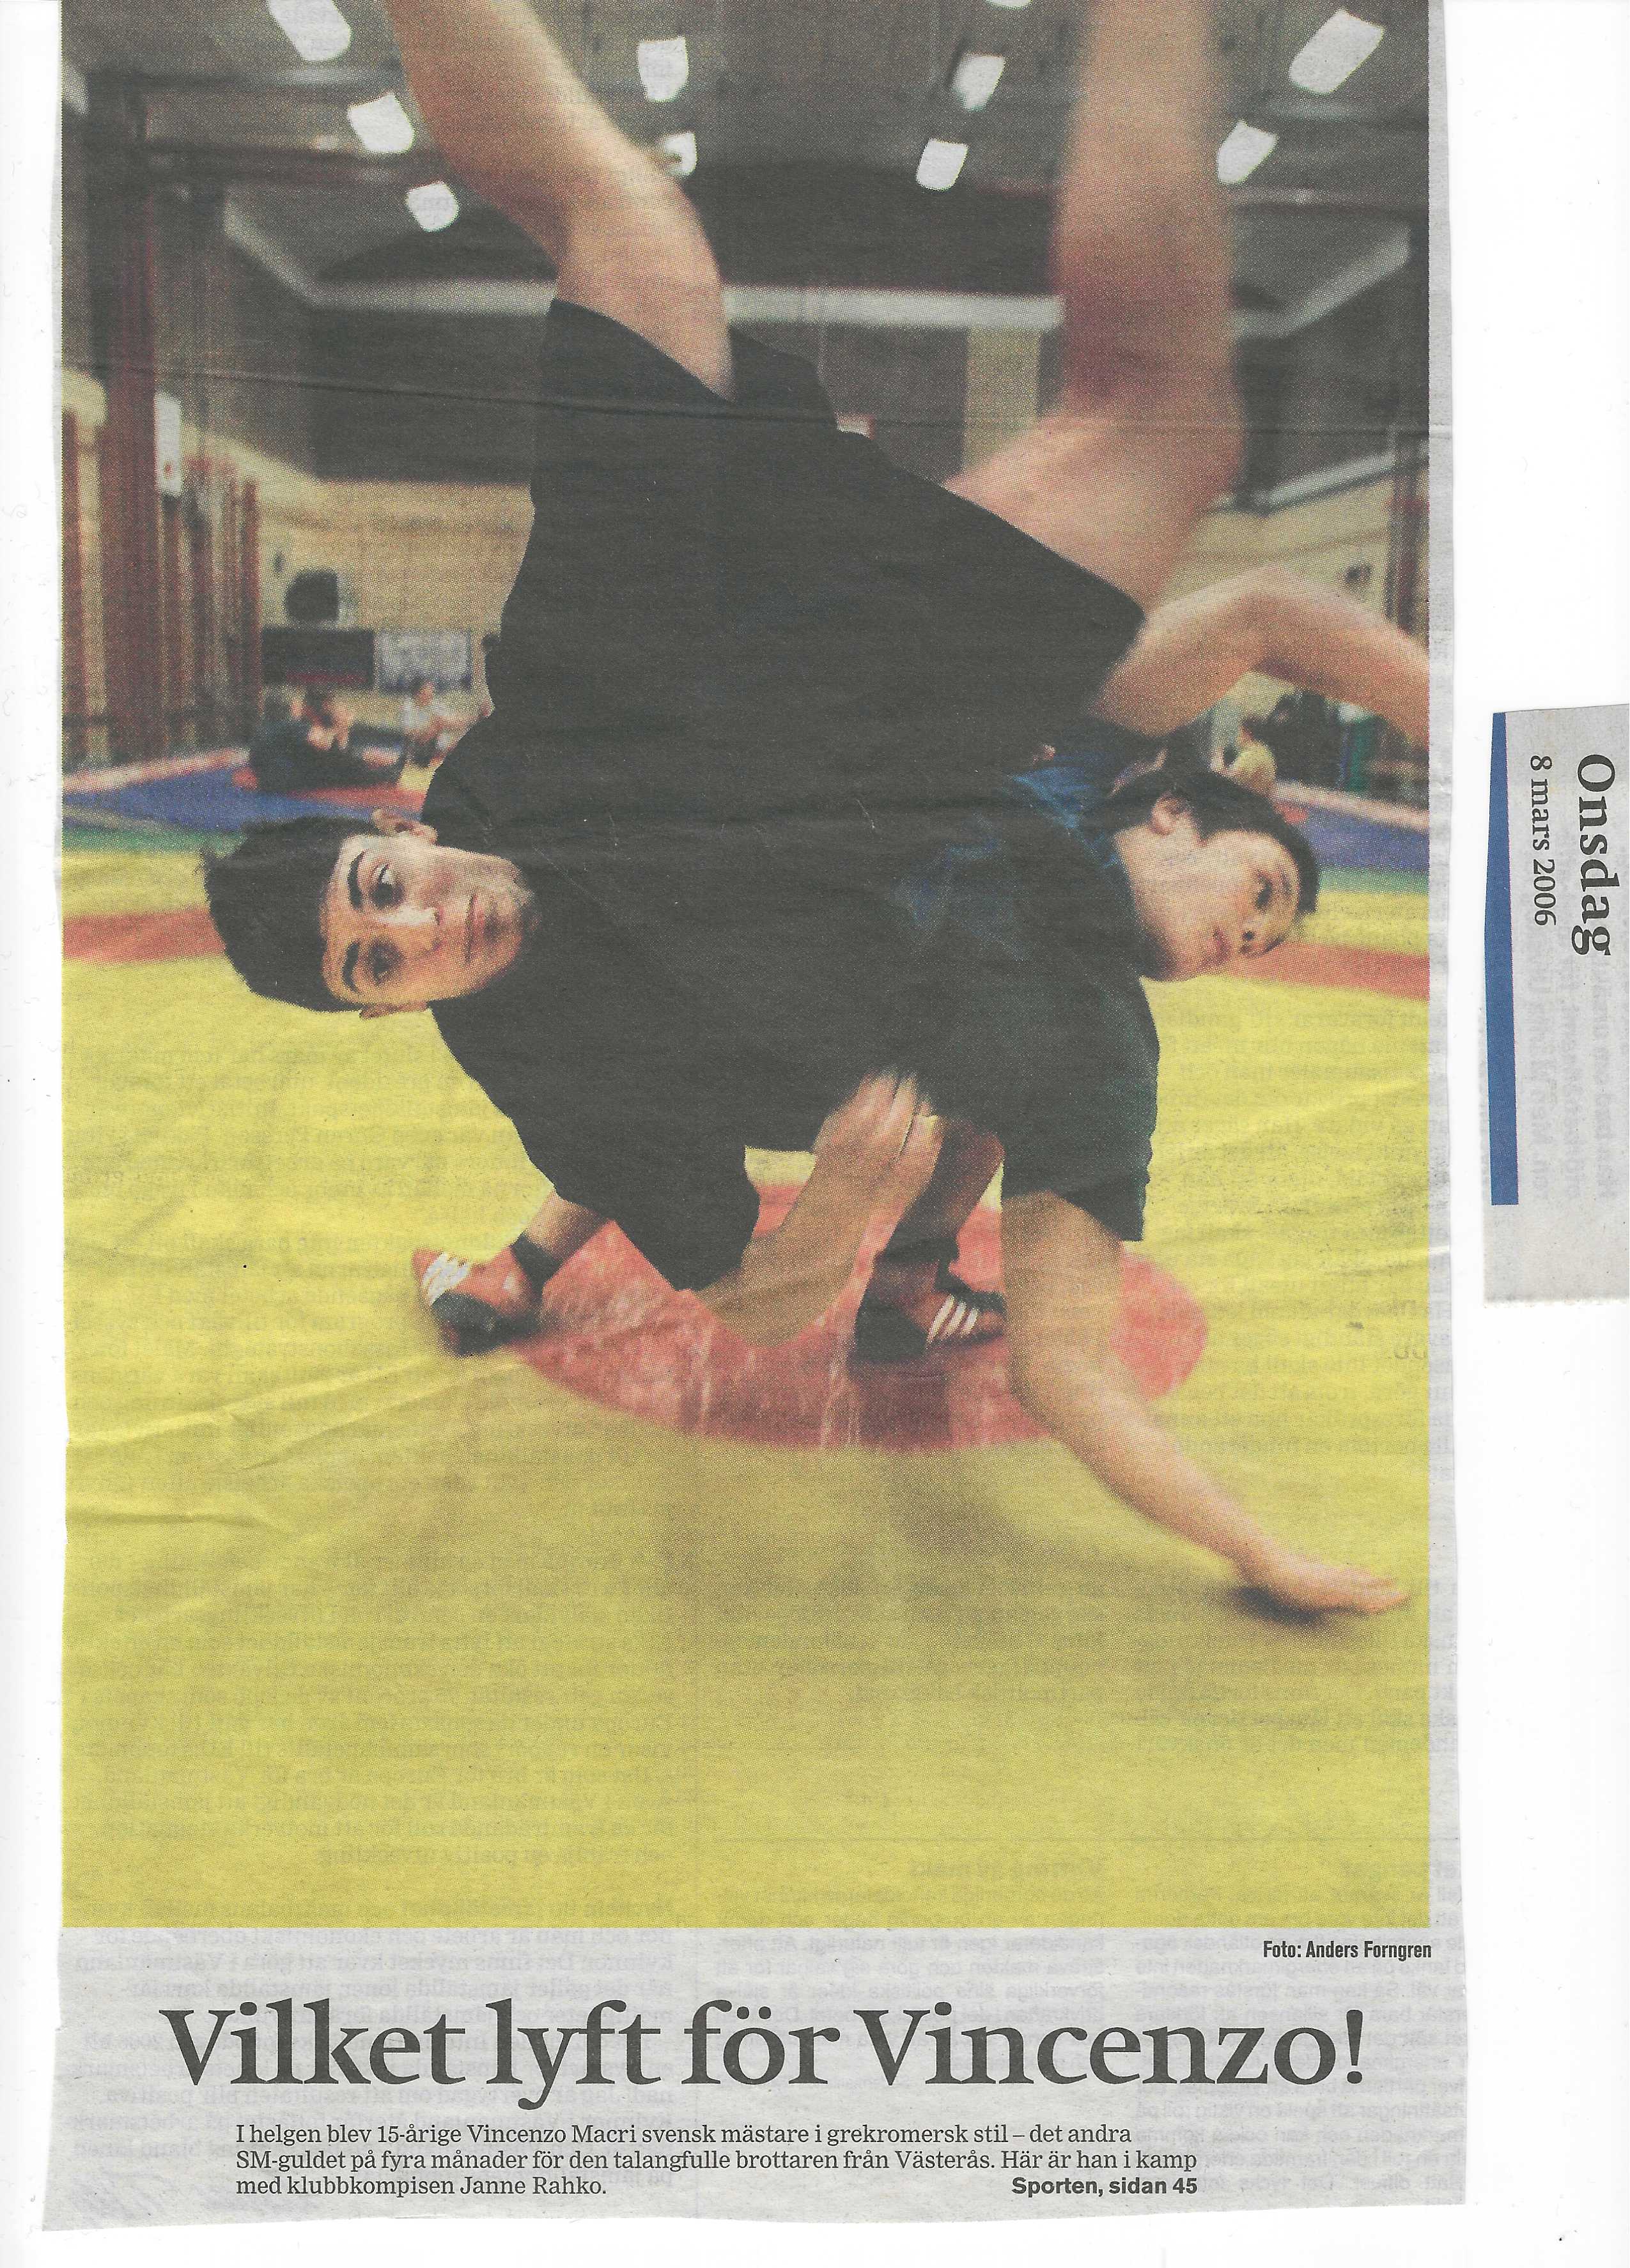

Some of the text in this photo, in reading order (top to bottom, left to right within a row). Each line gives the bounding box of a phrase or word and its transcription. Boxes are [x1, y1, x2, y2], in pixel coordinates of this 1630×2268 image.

[1530, 755, 1556, 926] 8 mars 2006
[1572, 755, 1620, 955] Onsdag
[1264, 1941, 1431, 1961] Foto: Anders Forngren
[159, 1998, 1363, 2110] Vilket lyft för Vincenzo!
[237, 2125, 244, 2142] I
[250, 2124, 322, 2146] helgen
[327, 2125, 371, 2142] blev
[378, 2124, 461, 2146] 15-årige
[467, 2125, 566, 2142] Vincenzo
[571, 2125, 637, 2142] Macri
[642, 2125, 716, 2142] svensk
[721, 2125, 809, 2142] mästare
[815, 2125, 821, 2142] i
[828, 2125, 968, 2146] grekromersk
[974, 2124, 1008, 2142] stil
[1030, 2124, 1062, 2142] det
[1069, 2124, 1131, 2142] andra
[237, 2150, 1197, 2172] SM-guldet på fyra månader för den talangfulle brottaren från Västerås. Här är han i kamp
[237, 2176, 606, 2198] med klubbkompisen Janne Rahko.
[1012, 2177, 1197, 2198] Sporten, sidan 45
